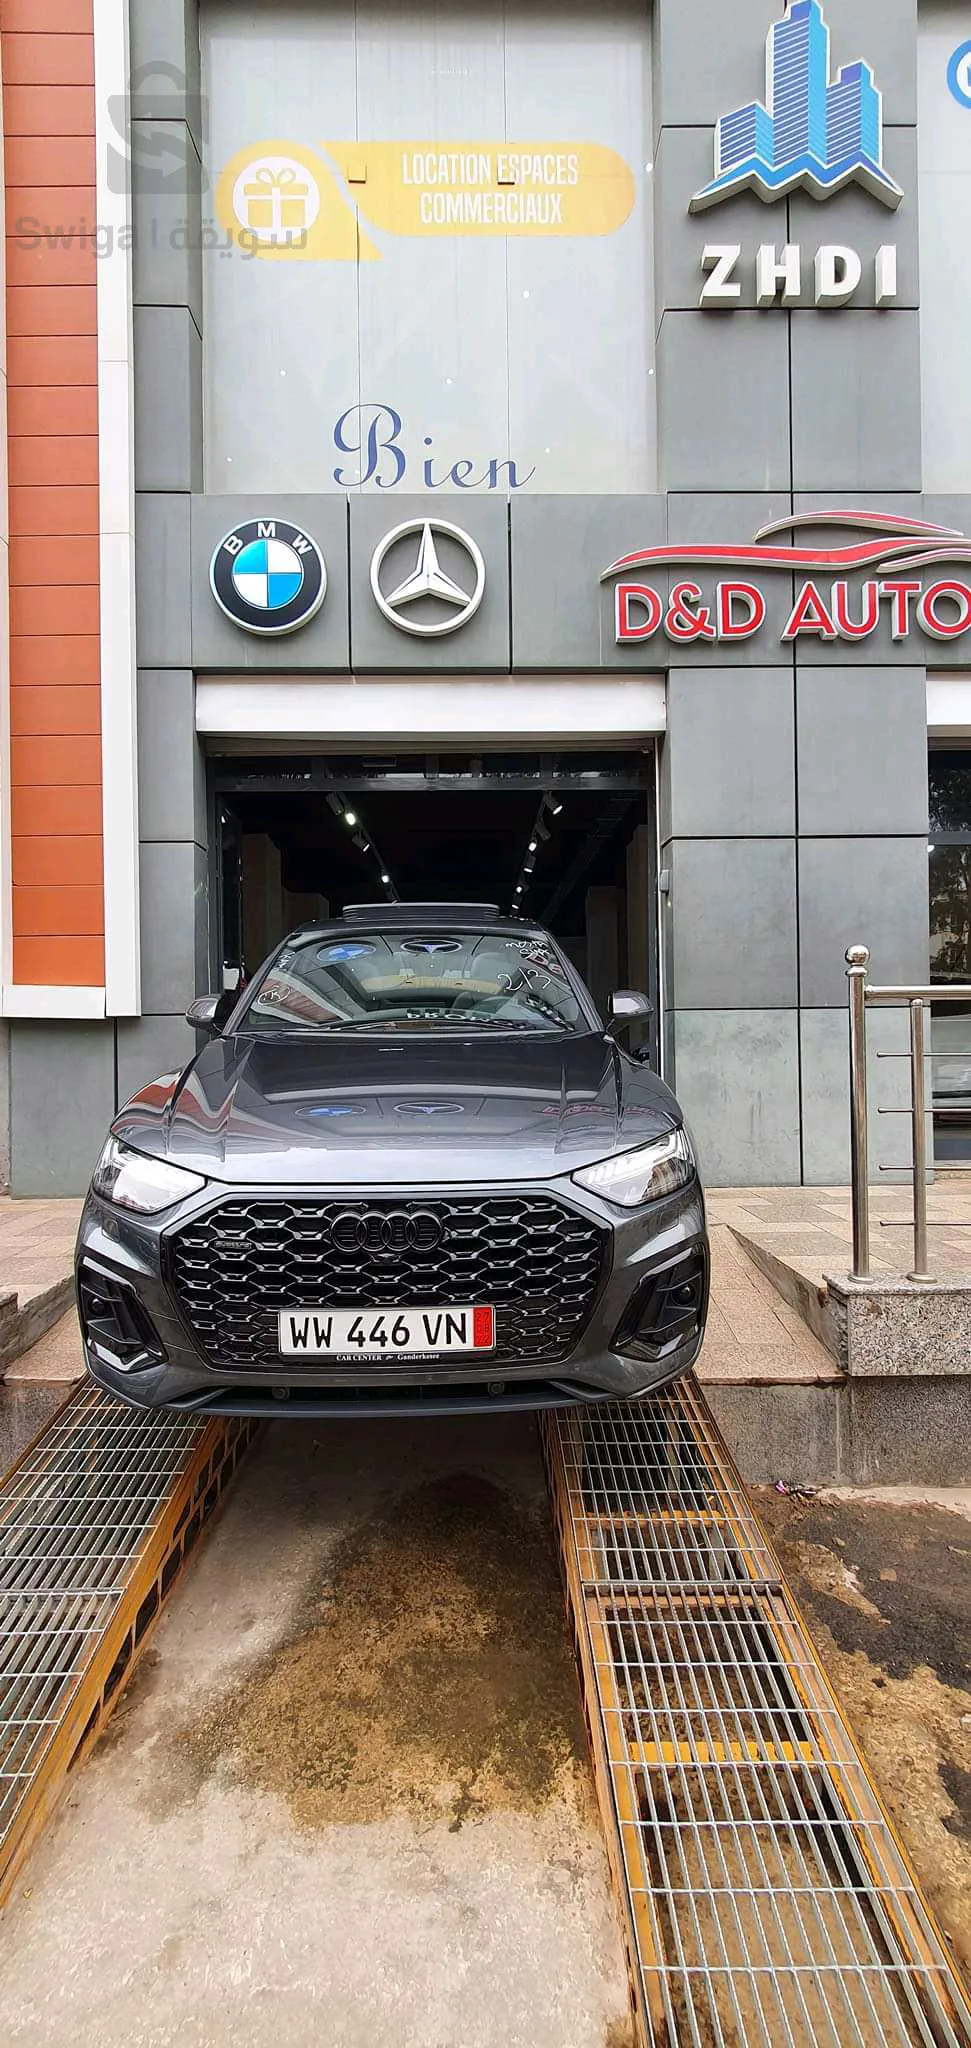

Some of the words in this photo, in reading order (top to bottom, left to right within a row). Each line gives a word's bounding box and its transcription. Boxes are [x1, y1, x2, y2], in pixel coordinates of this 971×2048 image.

[402, 154, 491, 185] LOCATION
[496, 154, 578, 185] ESPACES
[420, 192, 562, 224] COMMERCIAUX
[700, 243, 897, 306] ZHDI
[333, 403, 536, 489] Bien
[223, 521, 313, 556] BMW
[615, 581, 766, 643] D&D
[780, 580, 971, 642] AUTO
[289, 1317, 333, 1348] WW
[347, 1315, 410, 1347] 446
[422, 1313, 467, 1345] VN
[336, 1353, 351, 1361] CAR
[353, 1353, 382, 1361] CENTER
